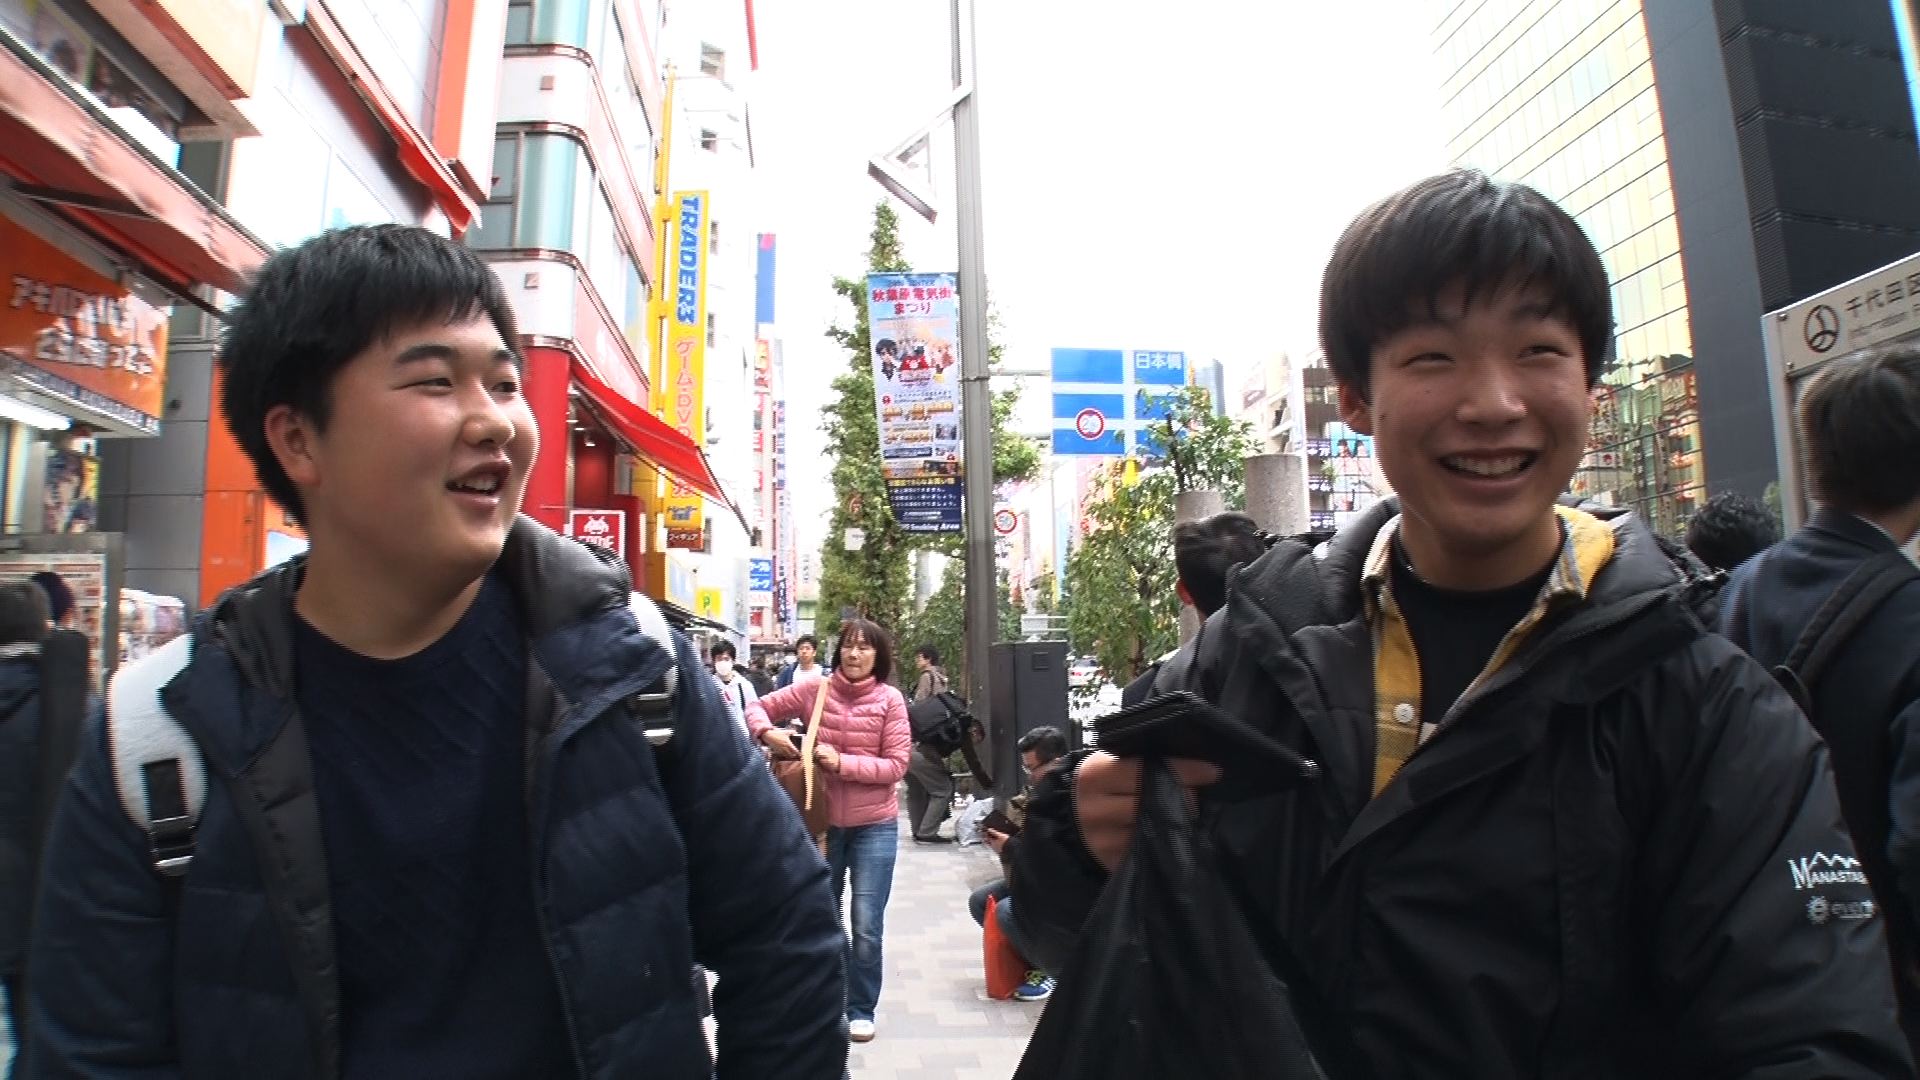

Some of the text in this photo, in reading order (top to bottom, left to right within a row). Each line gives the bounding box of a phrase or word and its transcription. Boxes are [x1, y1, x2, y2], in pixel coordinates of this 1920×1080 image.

[676, 195, 699, 324] TRADER3
[894, 302, 931, 315] まつり
[668, 533, 698, 541] フィギュア
